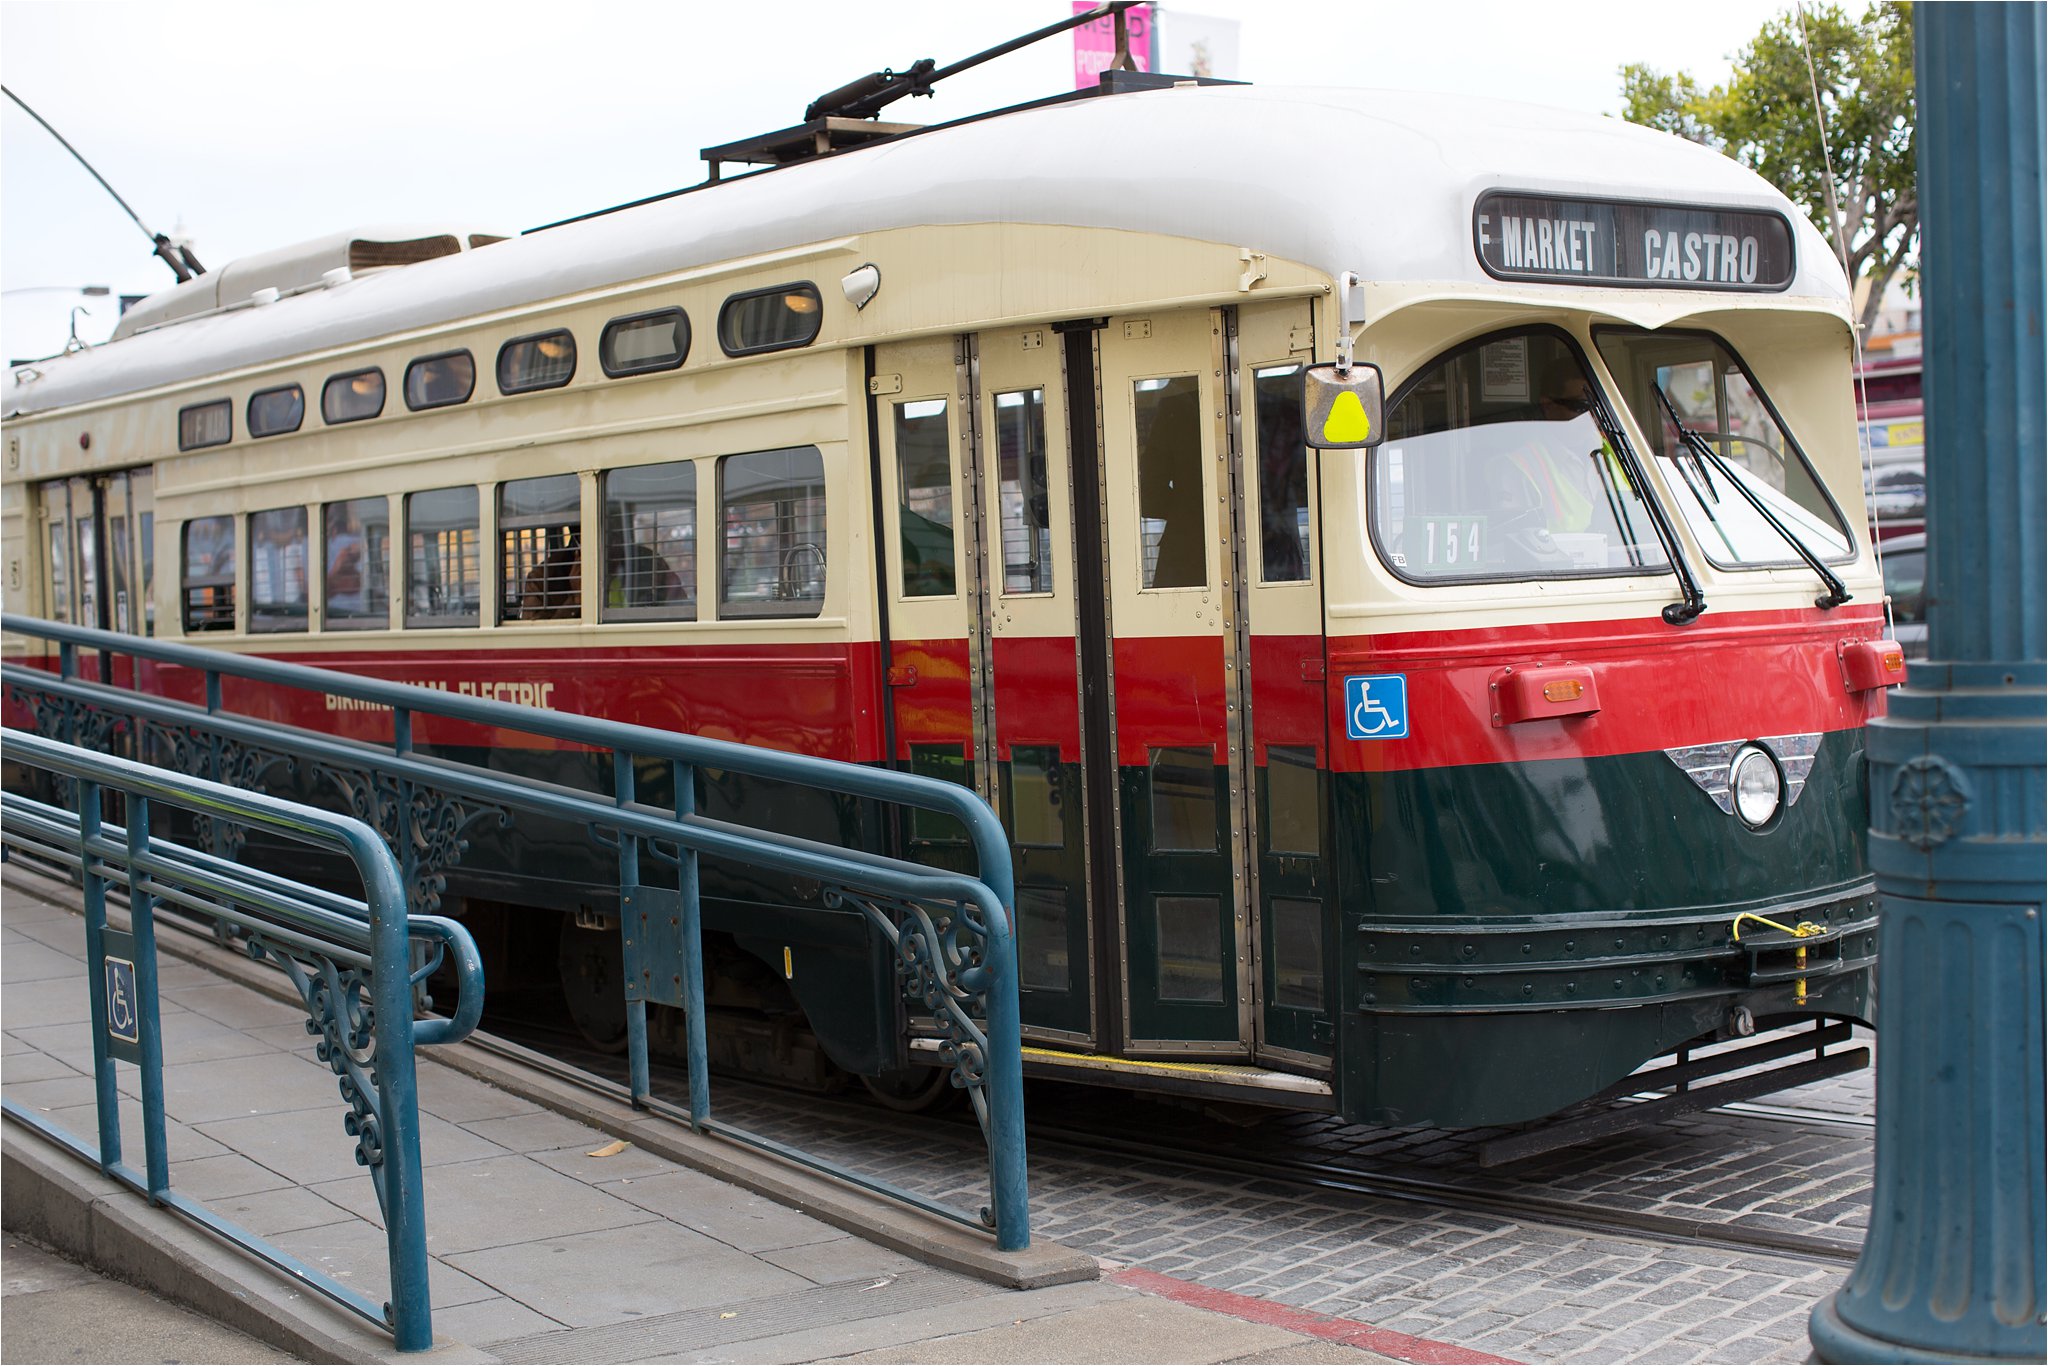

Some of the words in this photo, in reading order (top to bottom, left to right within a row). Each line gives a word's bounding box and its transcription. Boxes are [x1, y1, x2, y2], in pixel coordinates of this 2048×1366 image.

[1478, 215, 1489, 258] F
[1502, 215, 1595, 271] MARKET
[1644, 229, 1758, 284] CASTRO
[1426, 522, 1480, 564] 154
